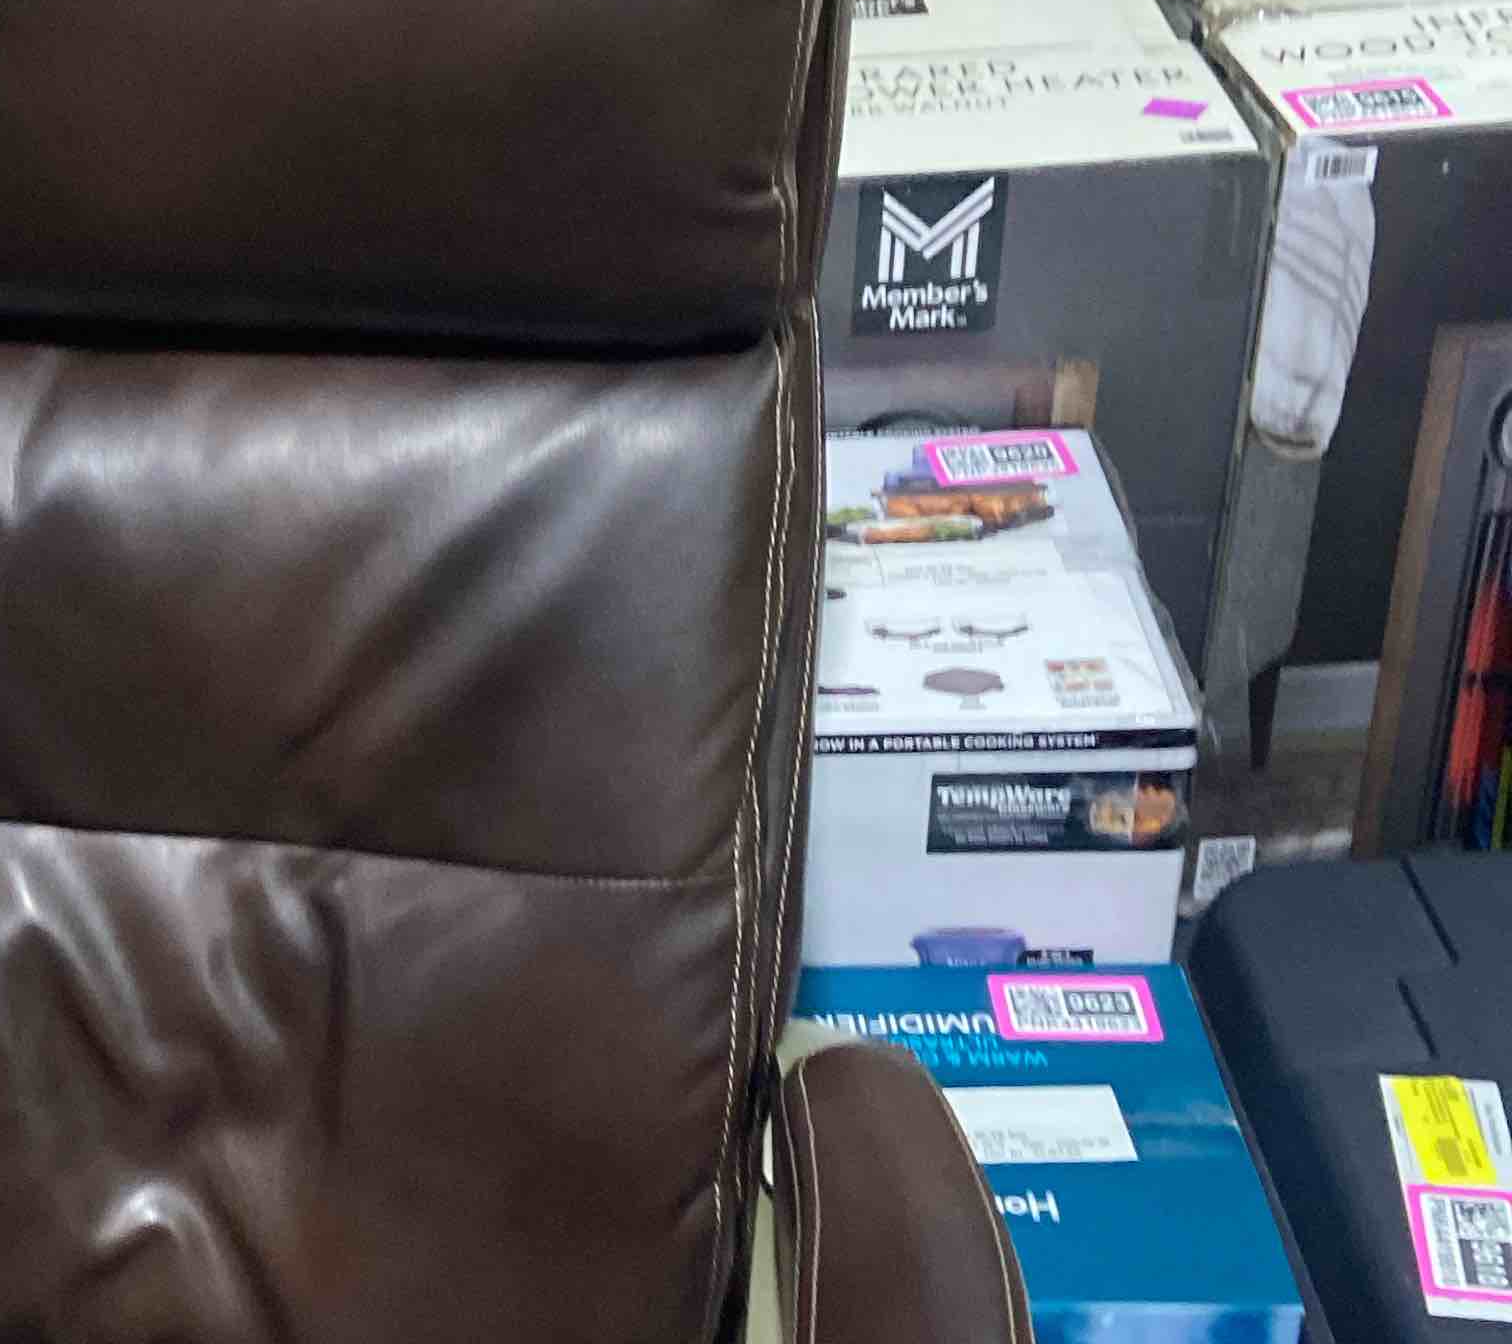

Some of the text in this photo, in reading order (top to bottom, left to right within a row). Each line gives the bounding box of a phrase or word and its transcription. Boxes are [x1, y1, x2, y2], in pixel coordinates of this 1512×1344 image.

[1260, 35, 1435, 63] WOOD
[1004, 66, 1192, 96] HEATER
[861, 277, 989, 311] Member's
[889, 304, 956, 331] Mark
[883, 735, 960, 751] PORTABLE
[964, 733, 1033, 750] COOKING
[1038, 732, 1097, 748] SYSTEM
